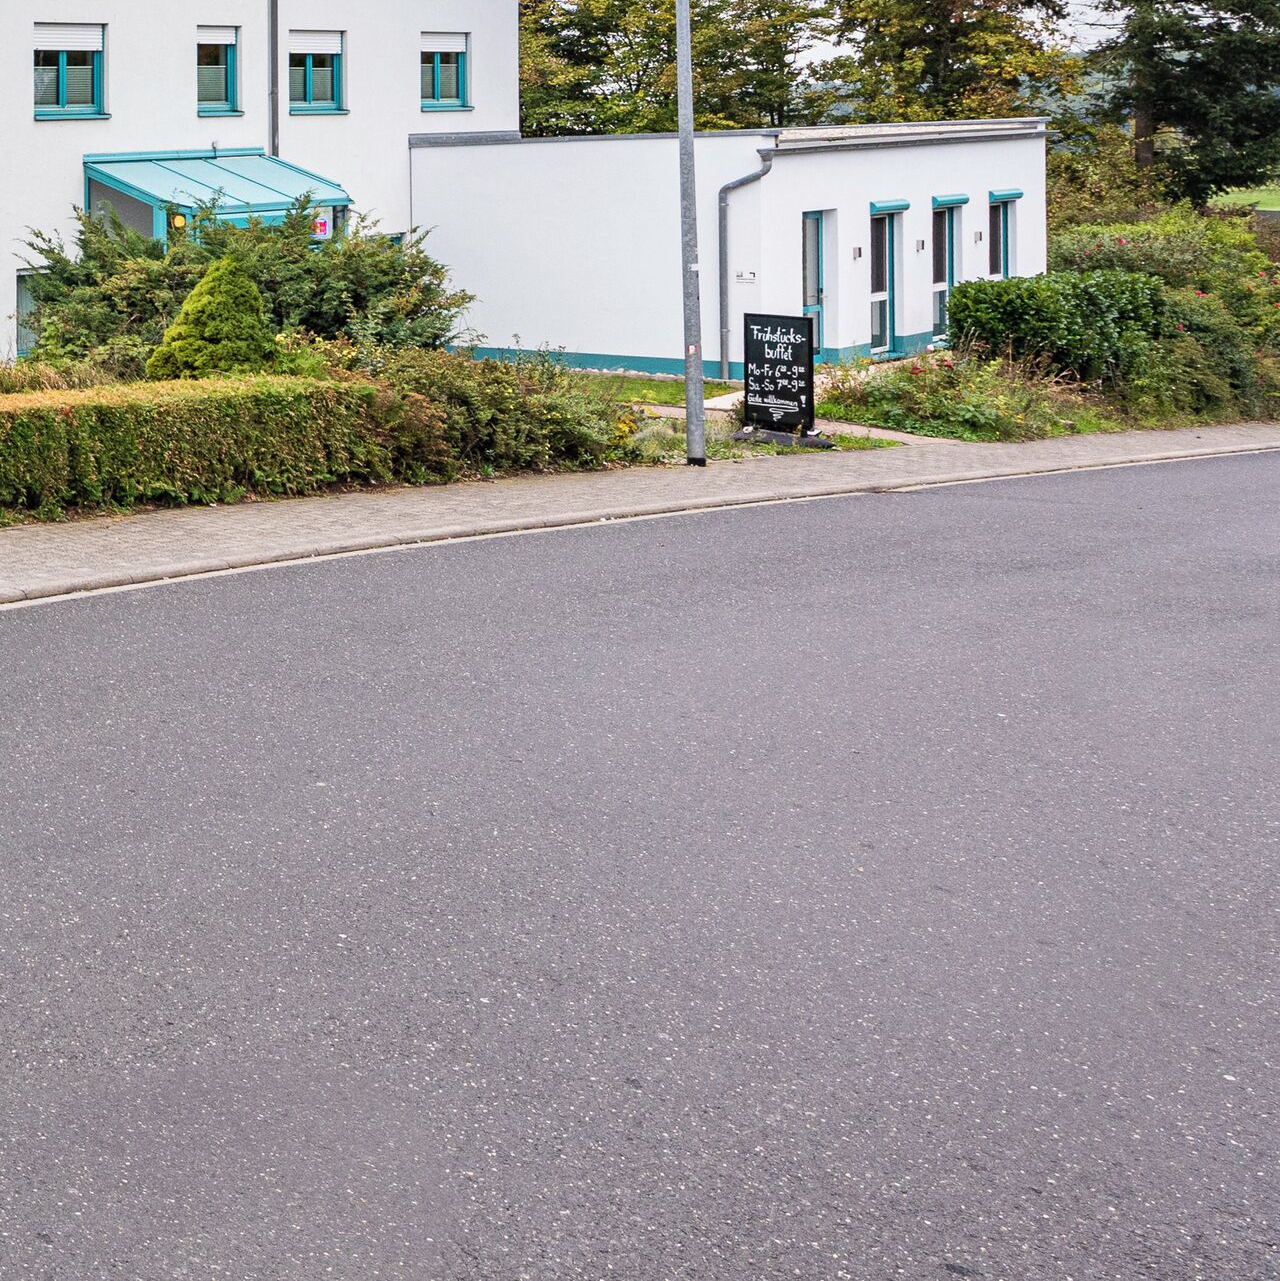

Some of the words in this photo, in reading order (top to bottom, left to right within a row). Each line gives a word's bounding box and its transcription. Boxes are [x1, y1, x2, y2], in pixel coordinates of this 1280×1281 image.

[750, 325, 806, 344] Frühstücks-
[765, 343, 793, 361] buffet
[748, 363, 773, 376] Mo-Fr
